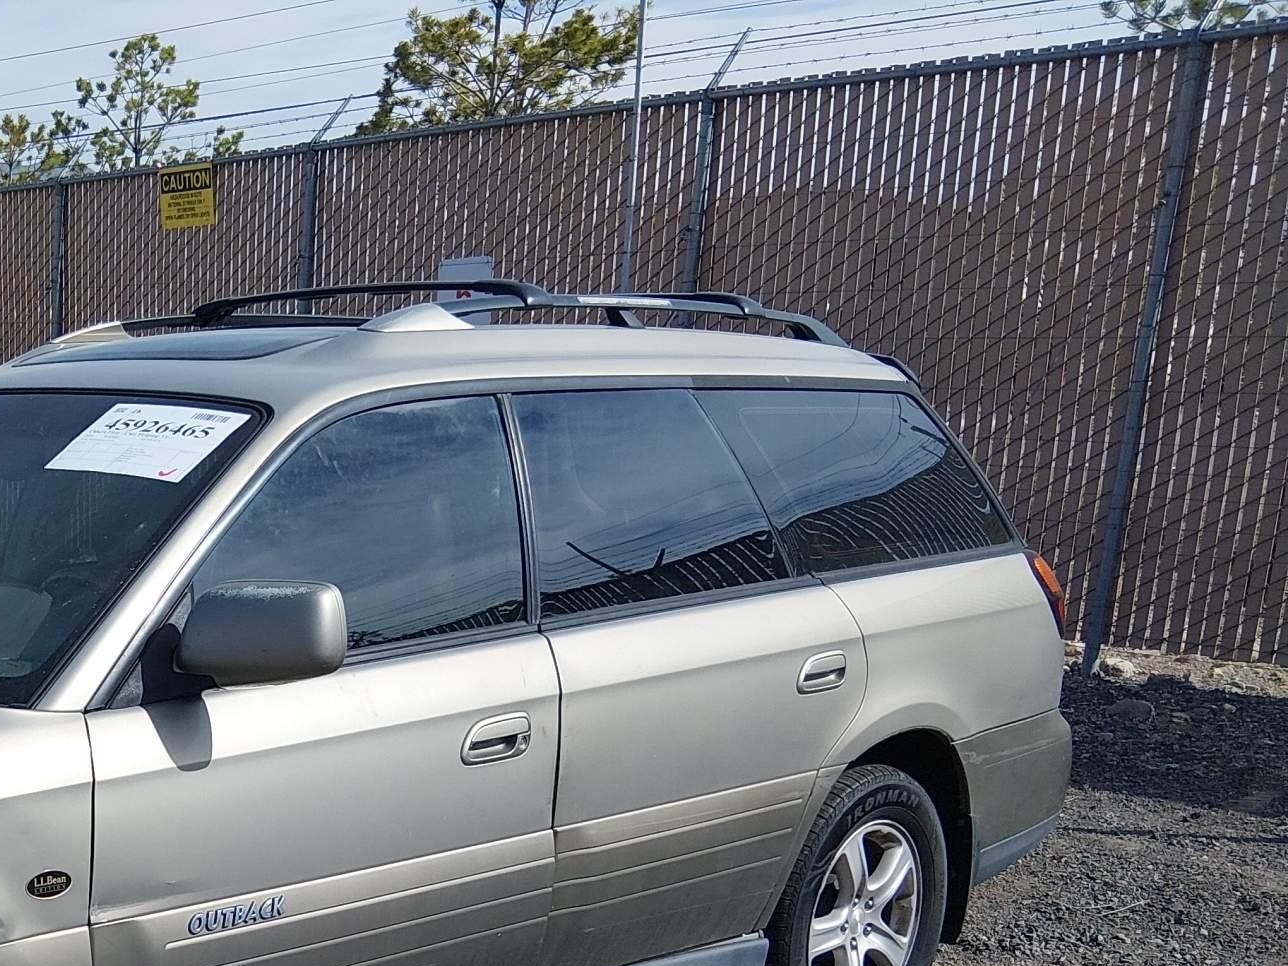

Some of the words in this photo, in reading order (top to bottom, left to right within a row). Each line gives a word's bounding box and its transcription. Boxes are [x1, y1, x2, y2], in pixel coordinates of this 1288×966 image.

[162, 169, 210, 192] CAUTION
[104, 418, 215, 439] 45926465
[848, 789, 920, 829] IRONMAN
[187, 895, 286, 935] OUTBACK
